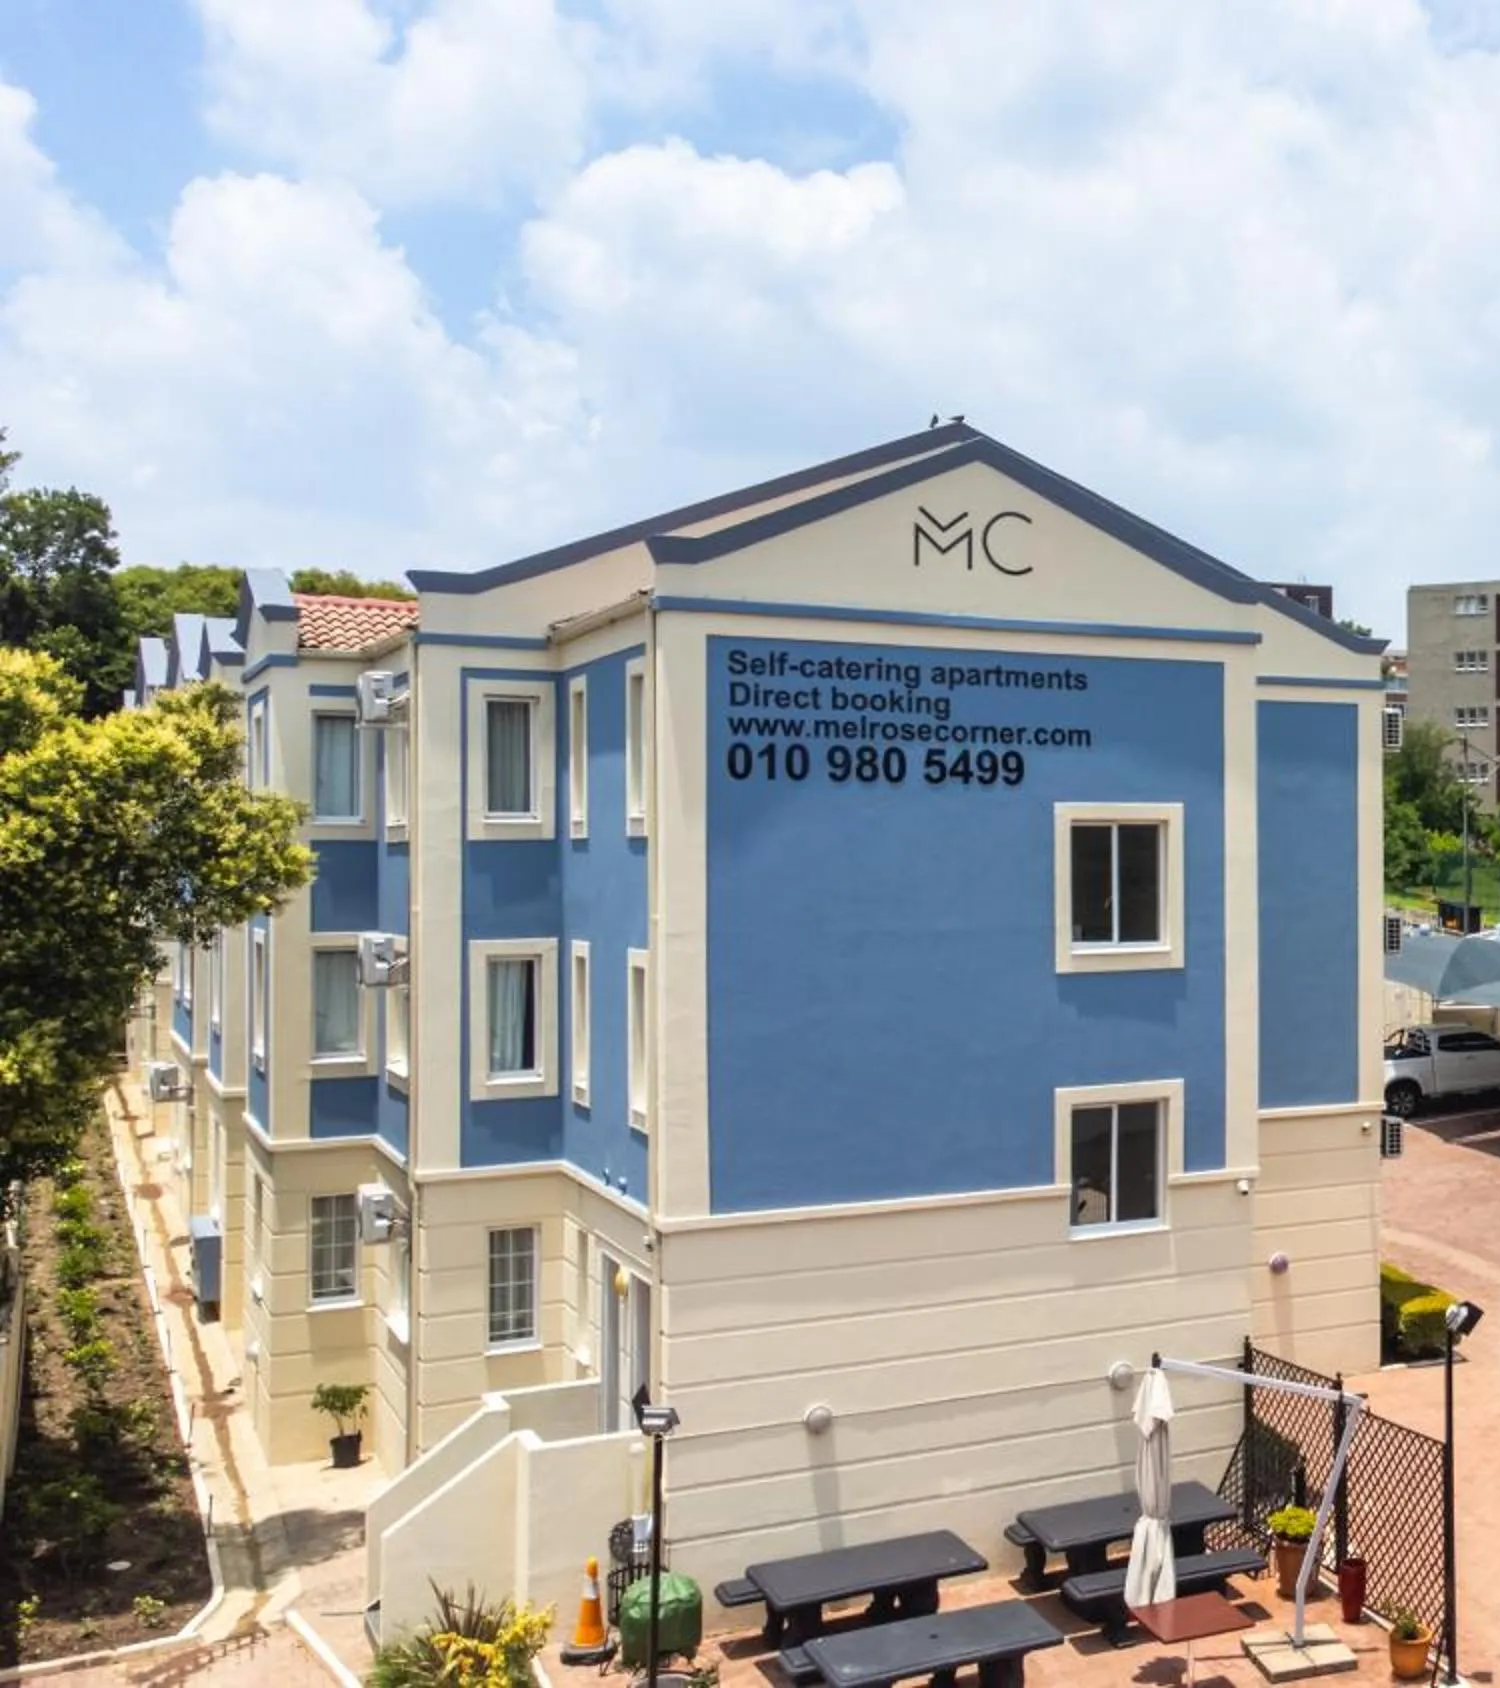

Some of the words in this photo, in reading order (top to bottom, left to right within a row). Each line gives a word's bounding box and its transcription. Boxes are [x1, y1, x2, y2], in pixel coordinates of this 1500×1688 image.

[727, 649, 921, 687] Self-catering
[930, 664, 1088, 691] apartments
[729, 682, 821, 710] Direct
[831, 686, 950, 720] booking
[728, 714, 1092, 747] www.melrosecorner.com
[727, 743, 810, 782] 010
[827, 746, 907, 783] 980
[923, 749, 1026, 786] 5499
